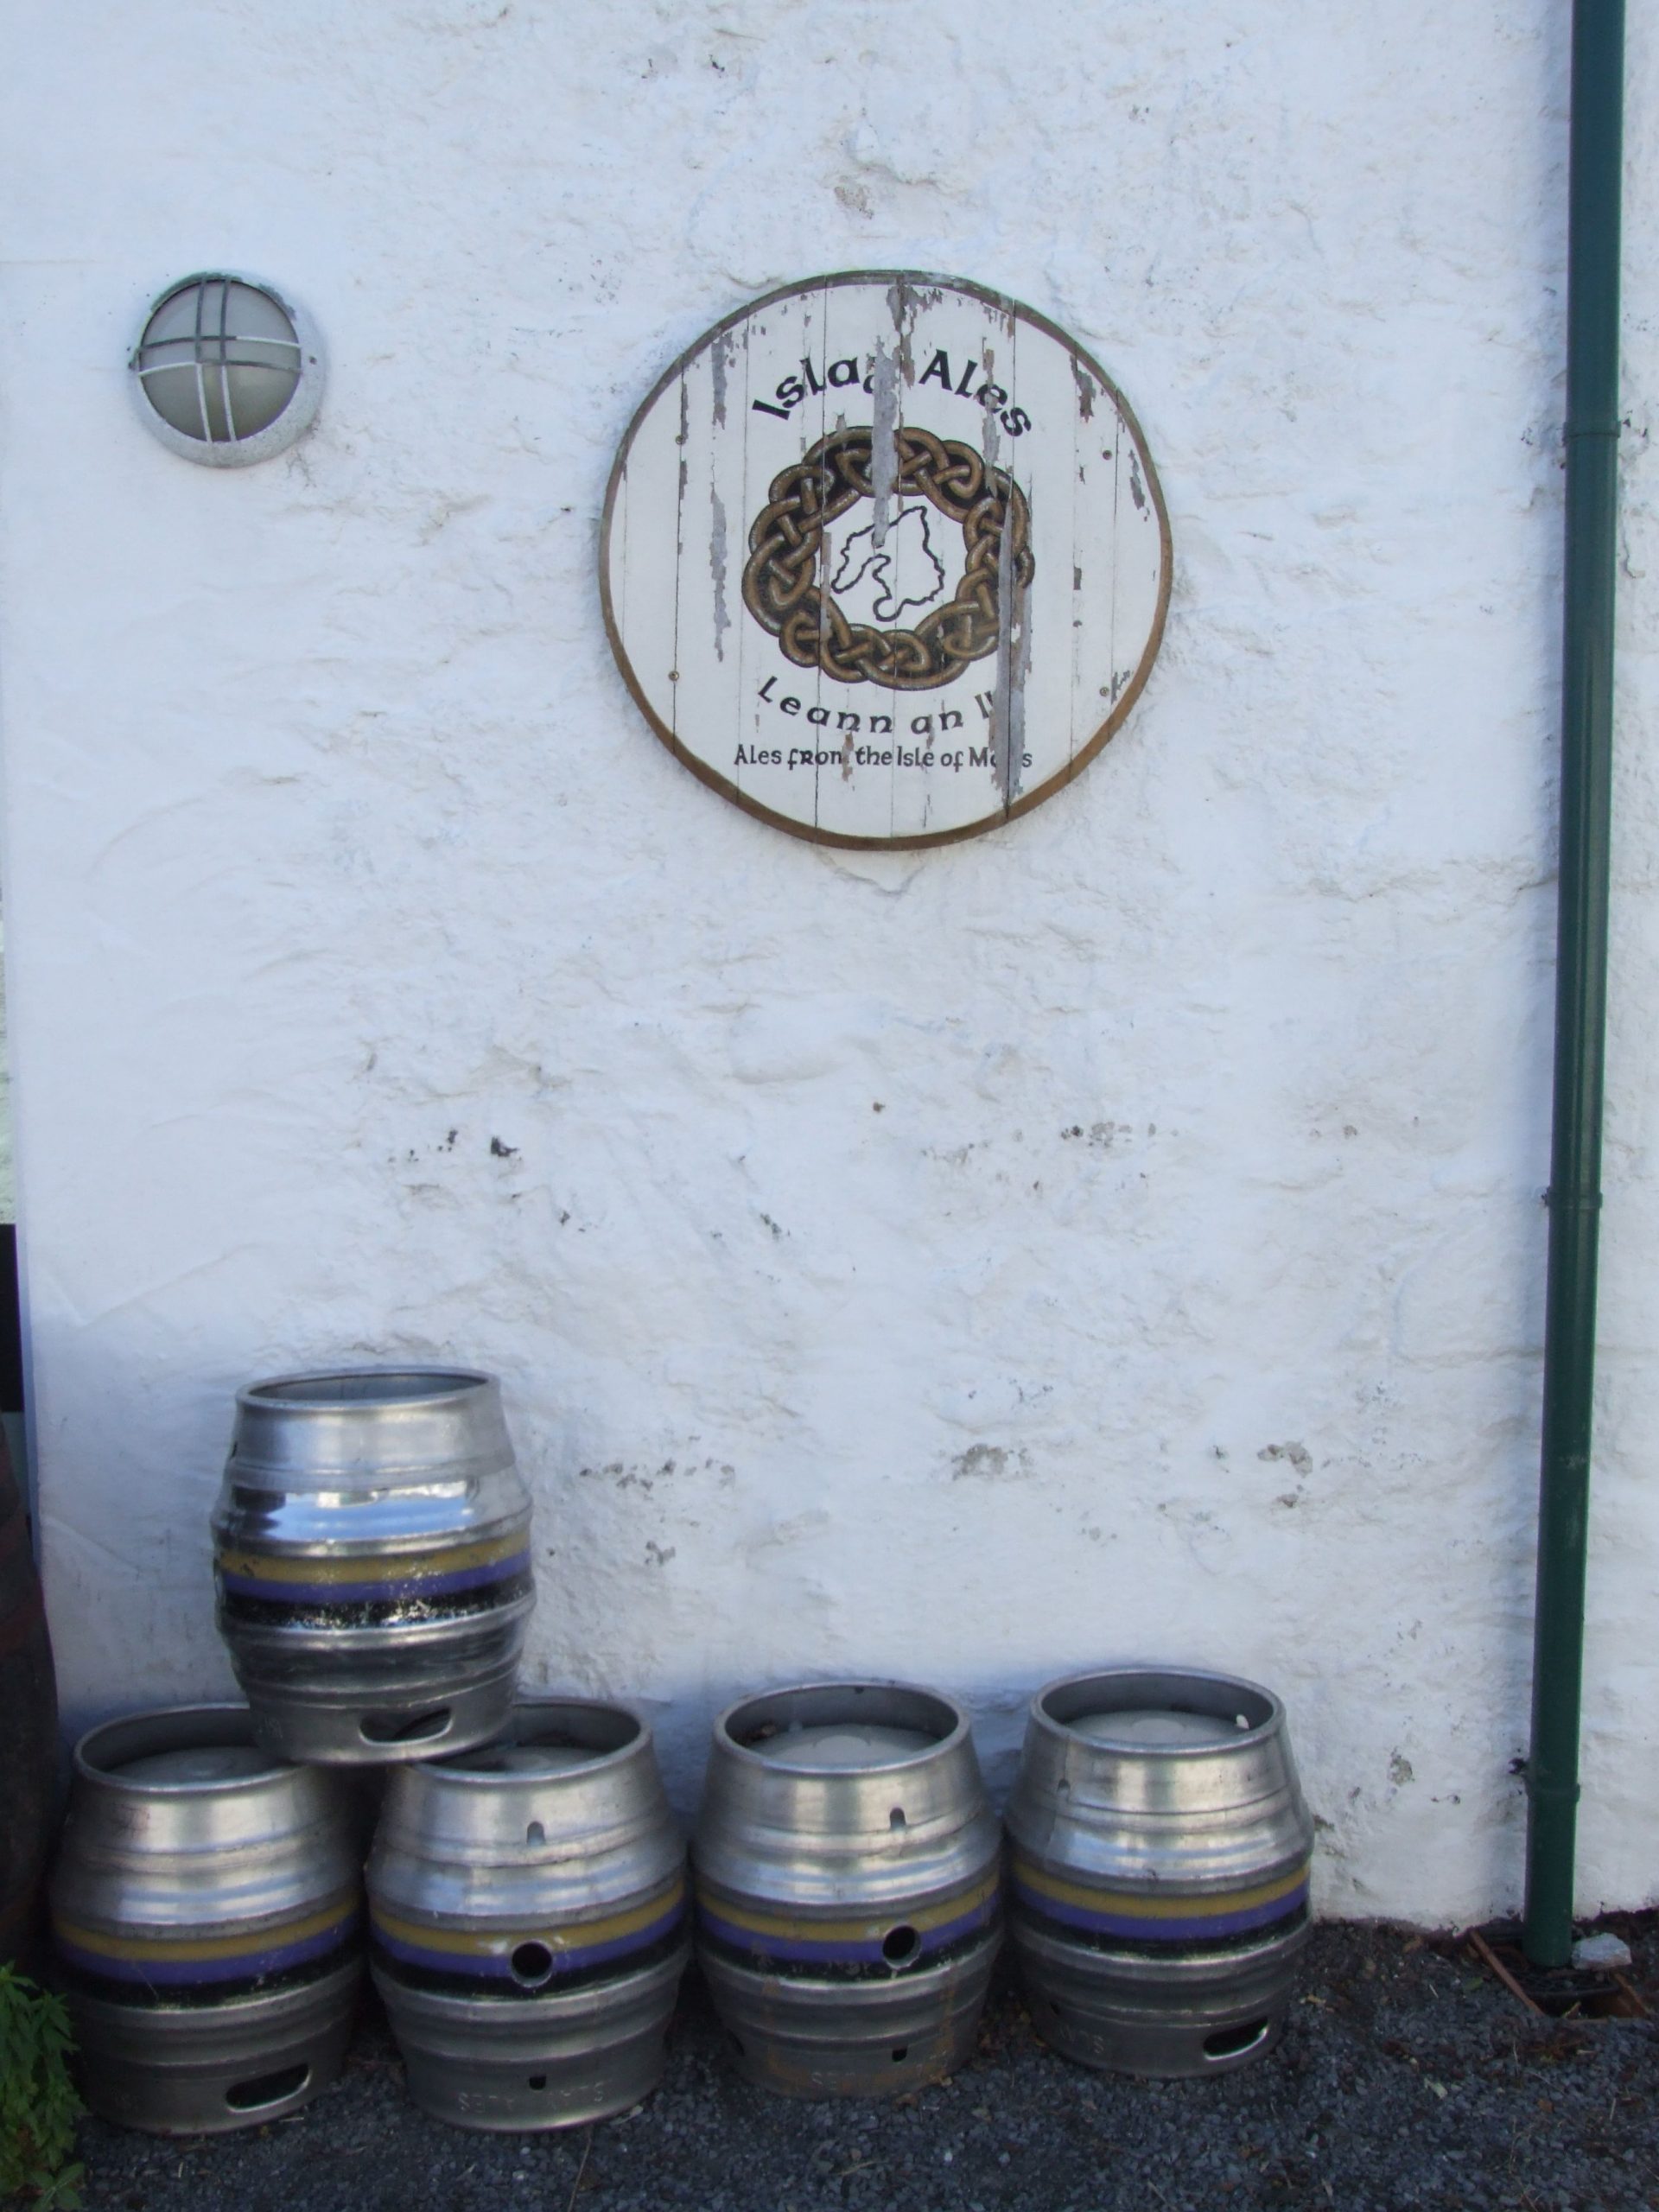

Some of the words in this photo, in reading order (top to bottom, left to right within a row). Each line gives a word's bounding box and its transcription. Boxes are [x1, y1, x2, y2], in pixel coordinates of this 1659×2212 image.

[752, 356, 878, 421] Isla
[918, 348, 1032, 437] Ales
[758, 676, 893, 734] Leann
[910, 709, 964, 735] an
[734, 744, 782, 766] Ales
[855, 745, 893, 766] the
[896, 746, 934, 767] Isle
[940, 751, 963, 772] of
